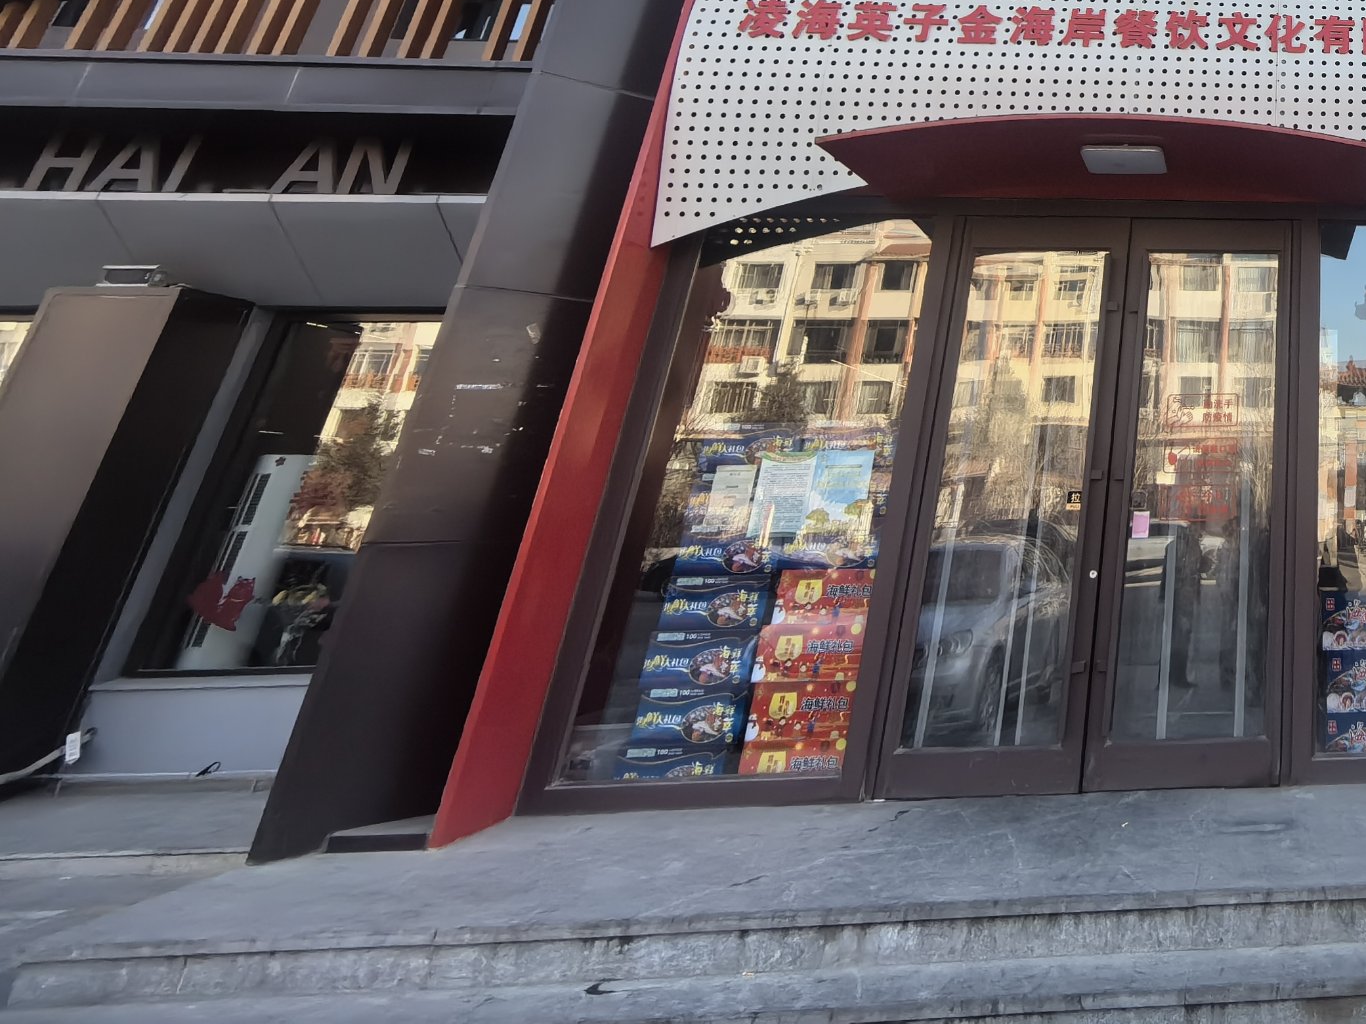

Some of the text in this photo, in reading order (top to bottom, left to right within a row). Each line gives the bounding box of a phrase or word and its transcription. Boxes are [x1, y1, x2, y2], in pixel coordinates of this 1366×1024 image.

[22, 132, 414, 195] HAI AN
[826, 584, 873, 598] 海鲜礼包
[807, 639, 855, 654] 海鲜礼包
[800, 696, 850, 712] 海鲜礼包
[790, 757, 839, 771] 海鲜礼包
